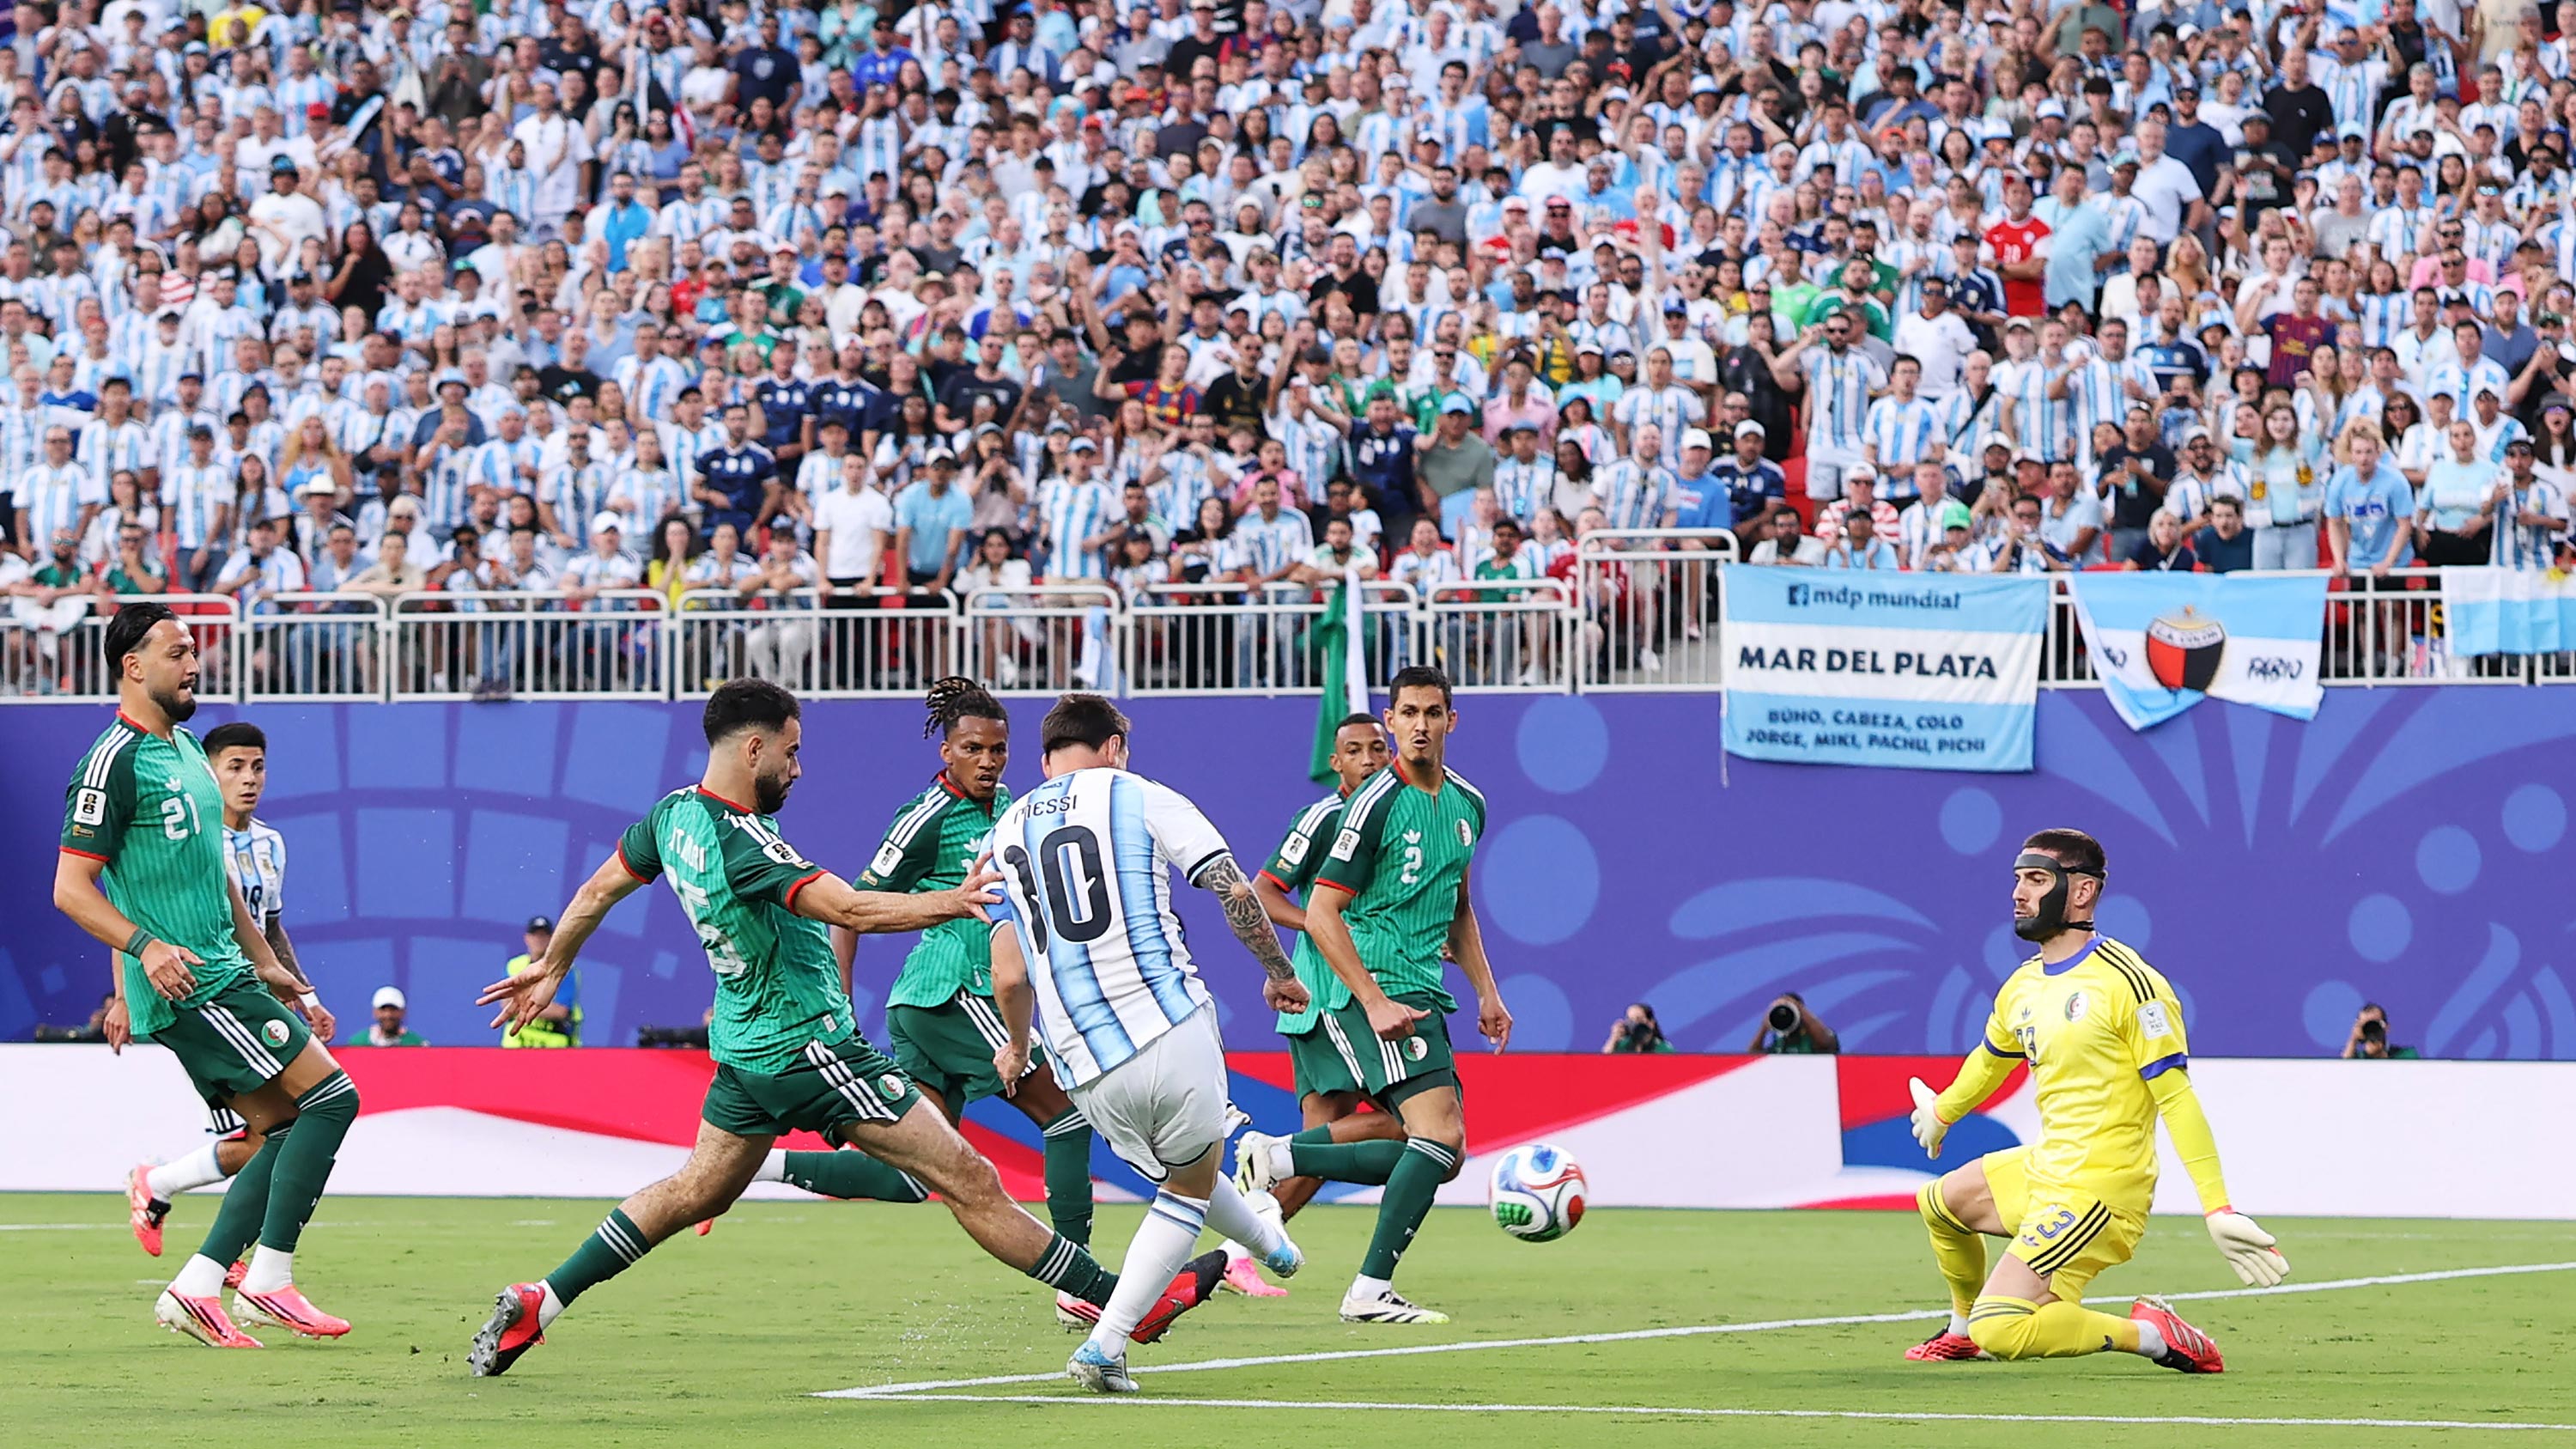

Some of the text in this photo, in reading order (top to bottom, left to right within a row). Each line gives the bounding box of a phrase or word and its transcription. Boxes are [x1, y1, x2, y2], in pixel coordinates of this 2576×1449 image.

[1814, 585, 1862, 610] mdp
[1868, 590, 1961, 609] mundial
[1739, 646, 1997, 678] MAR DEL PLATA
[1916, 715, 1964, 730] COLO
[161, 792, 202, 841] 21
[1014, 795, 1078, 825] MESSI
[1400, 846, 1422, 885] 2
[1003, 825, 1112, 955] 10
